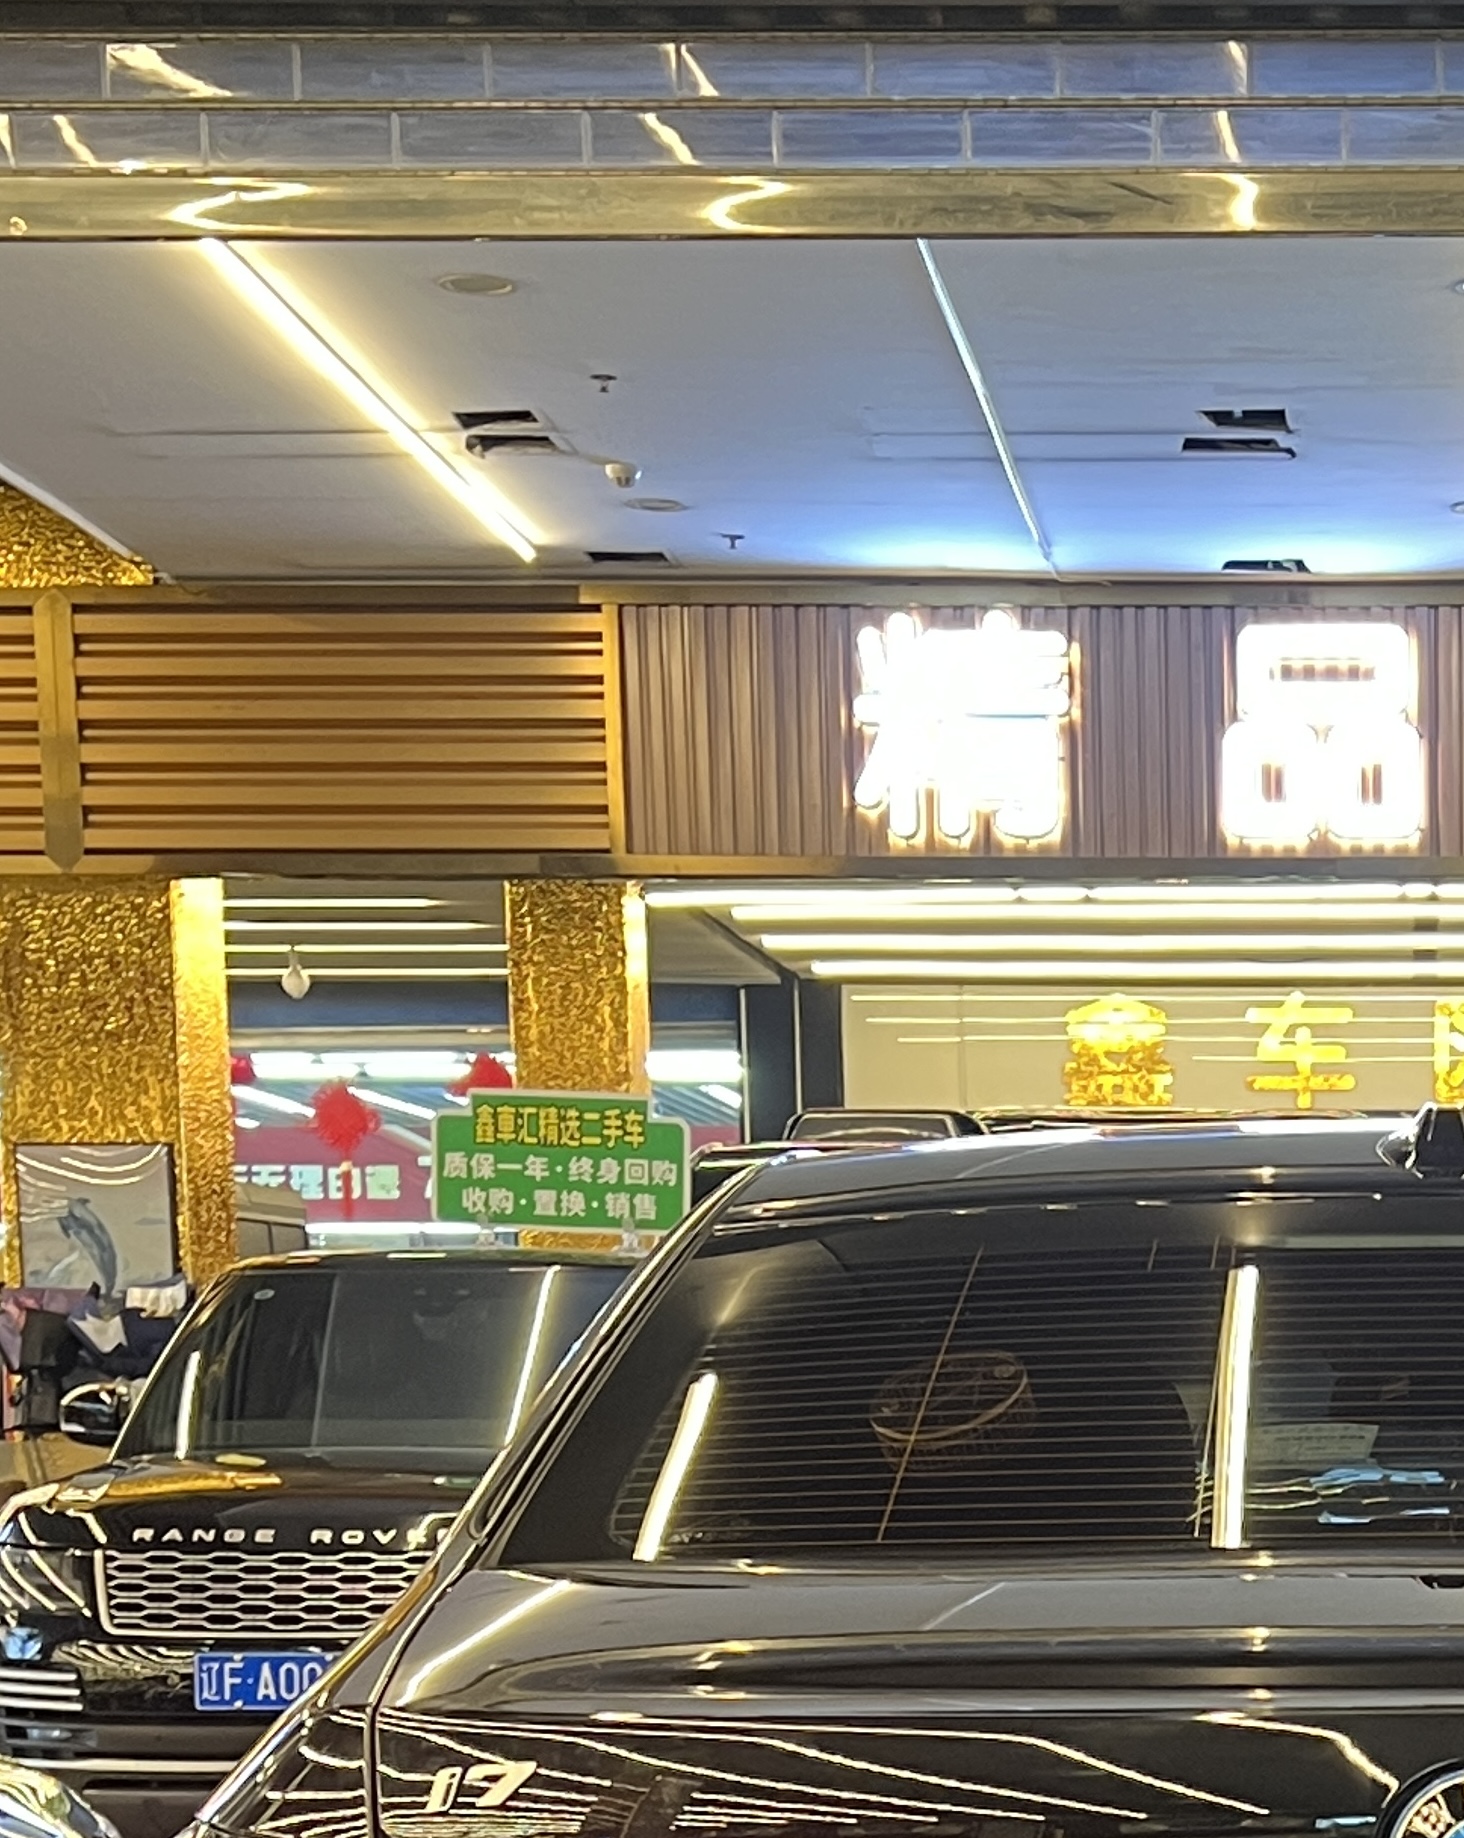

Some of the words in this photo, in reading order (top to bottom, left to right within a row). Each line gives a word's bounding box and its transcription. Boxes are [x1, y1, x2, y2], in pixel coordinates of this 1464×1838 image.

[442, 1151, 677, 1187] 质保一年·终身回购
[461, 1185, 658, 1221] 收购·置换·销售
[132, 1527, 276, 1543] RANGE
[424, 1761, 537, 1812] i7
